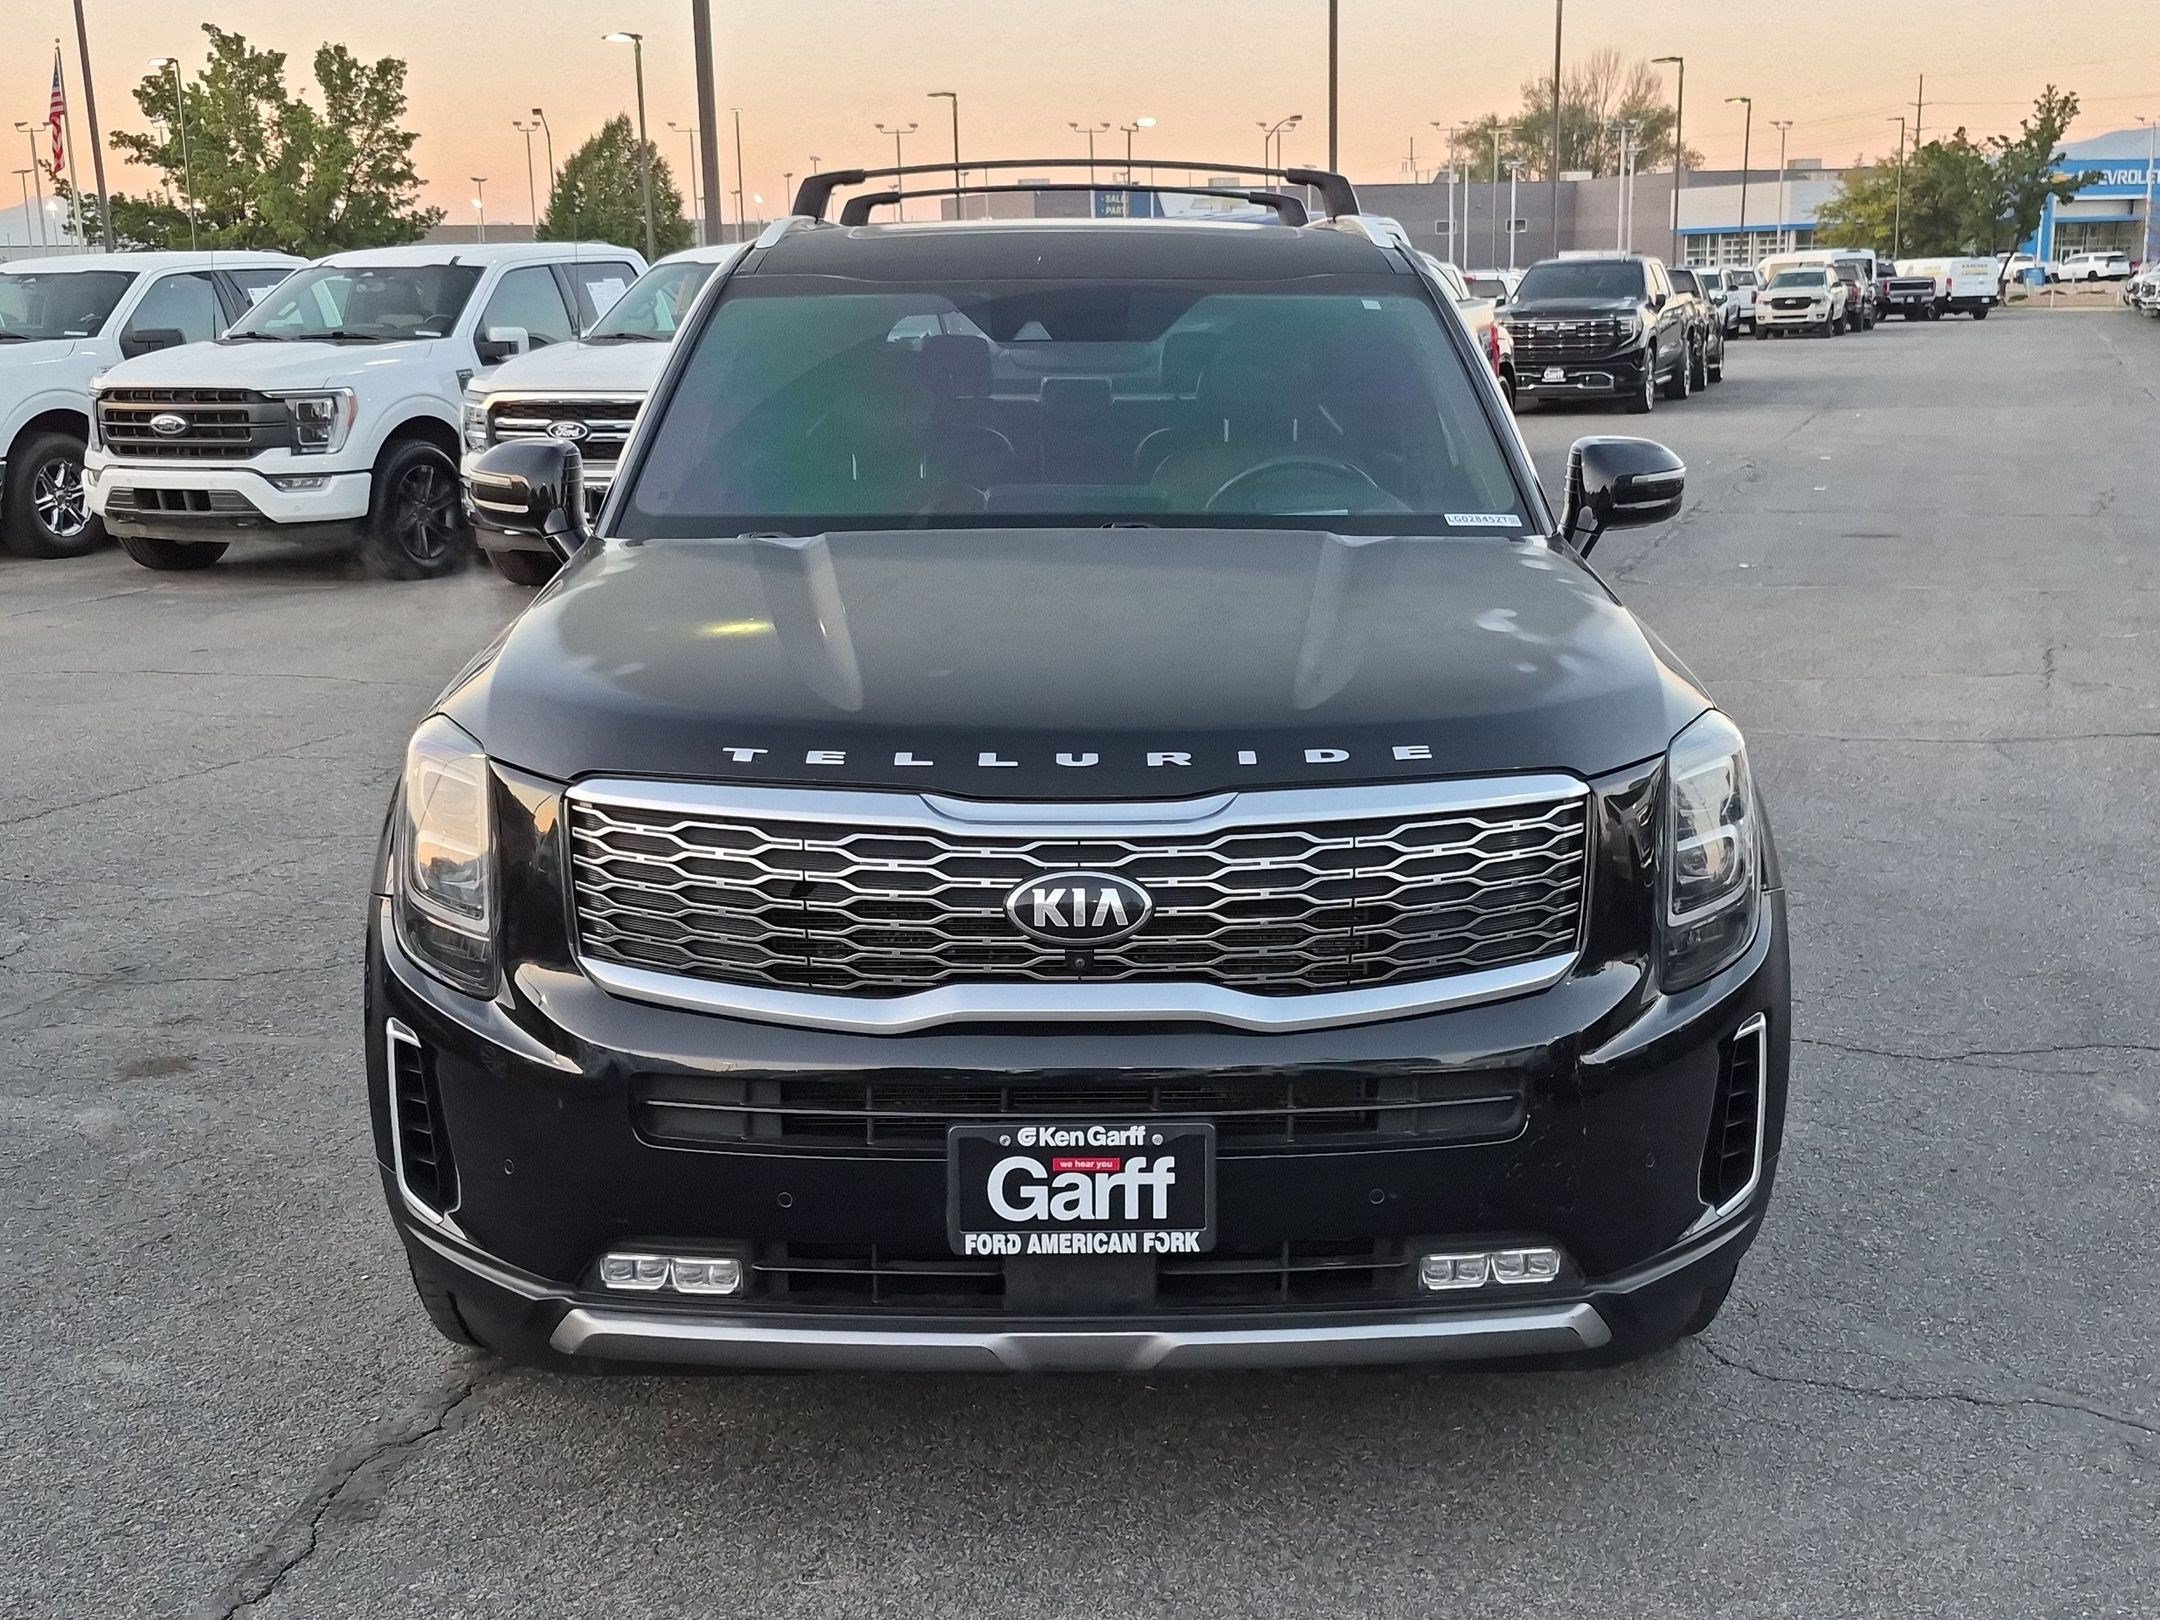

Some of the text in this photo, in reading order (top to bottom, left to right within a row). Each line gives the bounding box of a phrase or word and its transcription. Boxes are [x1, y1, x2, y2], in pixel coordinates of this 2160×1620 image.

[721, 744, 1433, 768] TELLURIDE
[1032, 888, 1129, 929] KIA
[1039, 1126, 1146, 1146] Ken Garff
[1075, 1160, 1095, 1168] hear
[1096, 1162, 1113, 1170] you
[987, 1156, 1176, 1222] Garff
[965, 1231, 1200, 1255] FORD AMERICAN FORK
